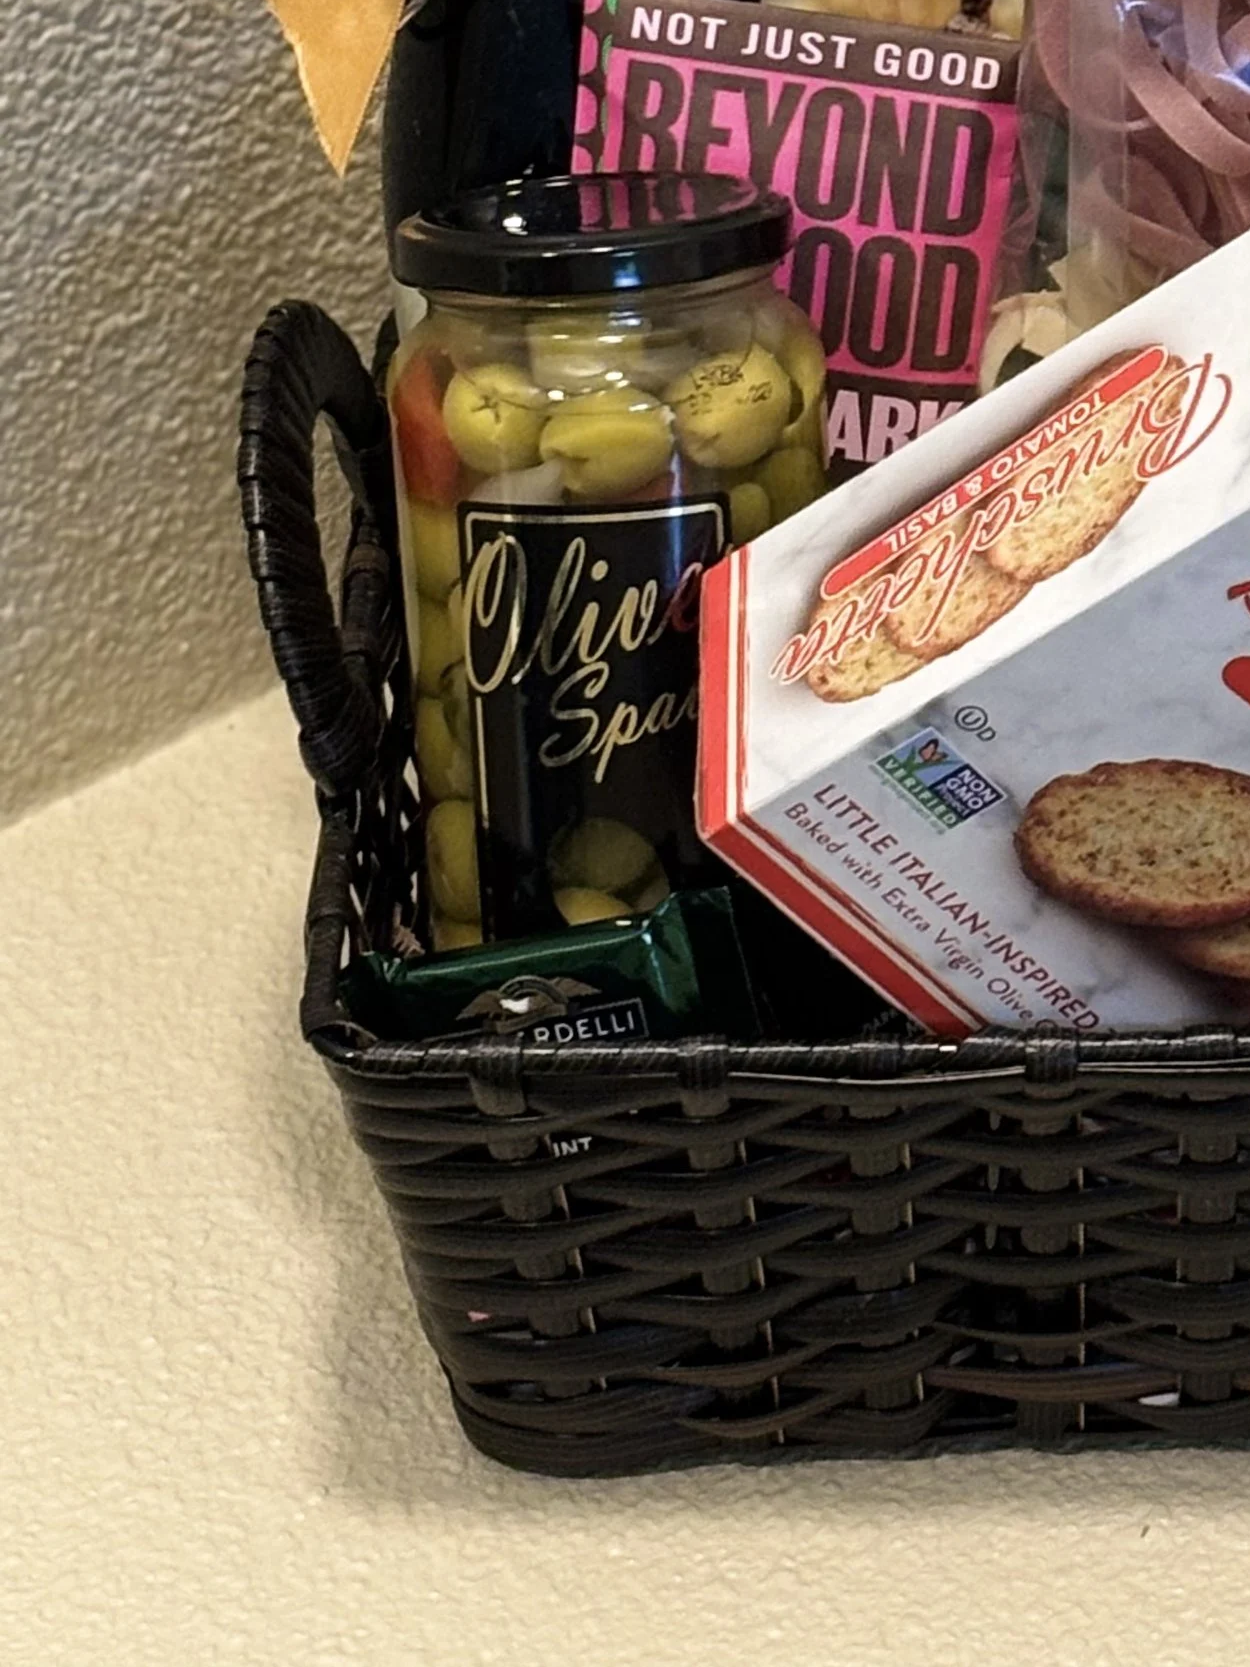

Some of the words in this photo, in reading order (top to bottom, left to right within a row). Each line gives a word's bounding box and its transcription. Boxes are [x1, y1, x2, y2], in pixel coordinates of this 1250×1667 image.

[629, 6, 727, 51] NOT
[740, 23, 856, 71] JUST
[874, 43, 1001, 91] GOOD
[618, 57, 994, 237] BEYOND
[790, 226, 981, 373] OOD
[824, 390, 964, 463] ARK
[991, 390, 1107, 480] TOMATO
[770, 352, 1233, 684] Bruschetta
[882, 493, 958, 553] BASIL
[965, 477, 984, 497] &
[464, 531, 704, 692] Olive
[884, 759, 956, 825] VERIFIED
[946, 778, 982, 809] GMO
[959, 769, 997, 802] NON
[784, 802, 848, 854] Baked
[843, 853, 881, 889] with
[881, 887, 931, 932] Extra
[933, 928, 984, 979] Virgin
[987, 977, 1033, 1021] Olive
[814, 784, 898, 855] LITTLE
[889, 851, 1099, 1031] ITALIAN-INSPIRED
[518, 1009, 636, 1044] RDELLI
[553, 1136, 594, 1159] INT
